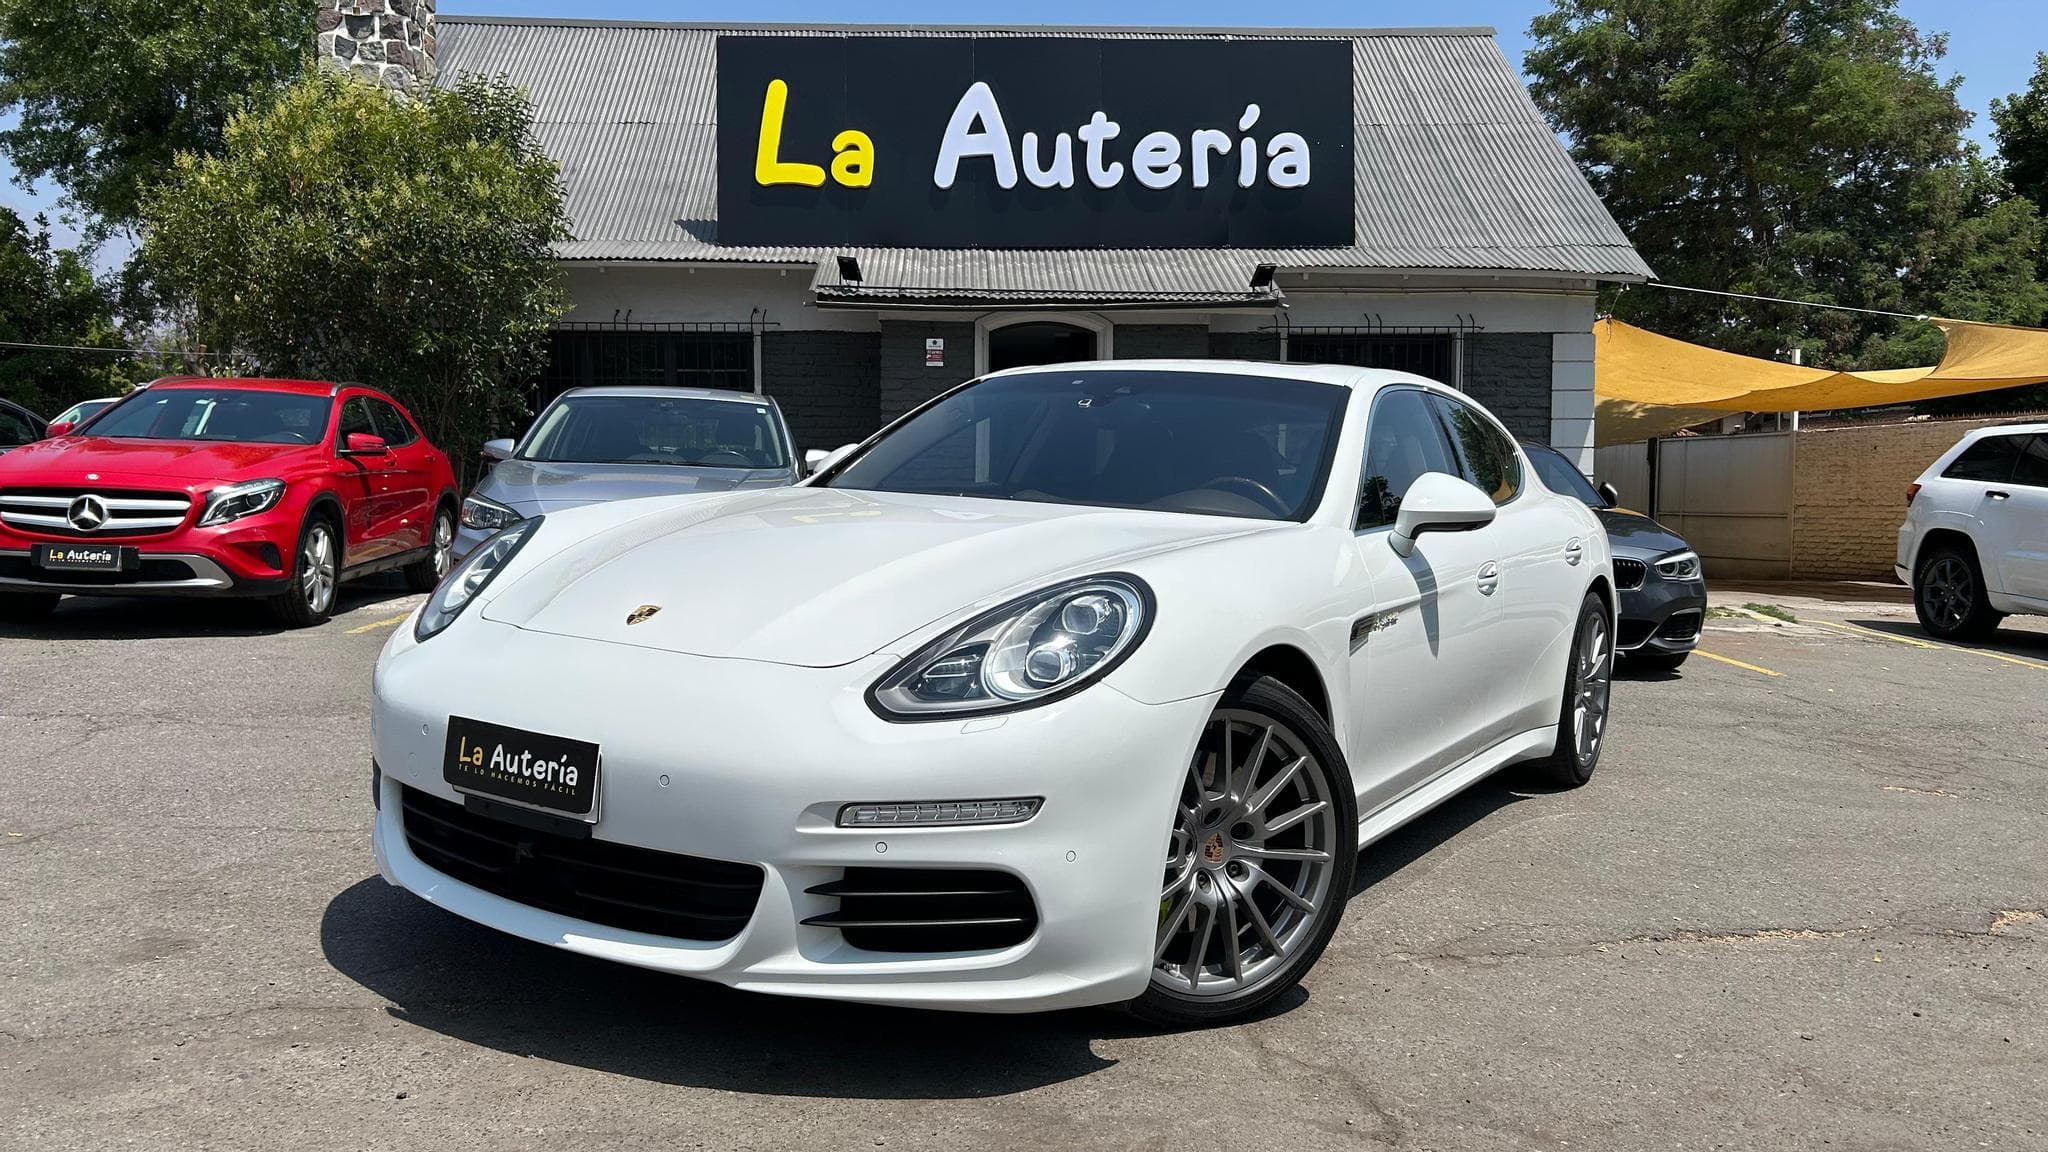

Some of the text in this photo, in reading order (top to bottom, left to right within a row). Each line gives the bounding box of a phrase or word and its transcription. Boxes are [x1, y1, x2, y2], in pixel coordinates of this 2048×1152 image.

[755, 79, 1311, 190] La Autería
[49, 549, 112, 561] La Autería
[458, 763, 469, 772] TE
[474, 767, 485, 776] LO
[491, 771, 537, 788] HACEMOS
[459, 736, 579, 786] La Autería
